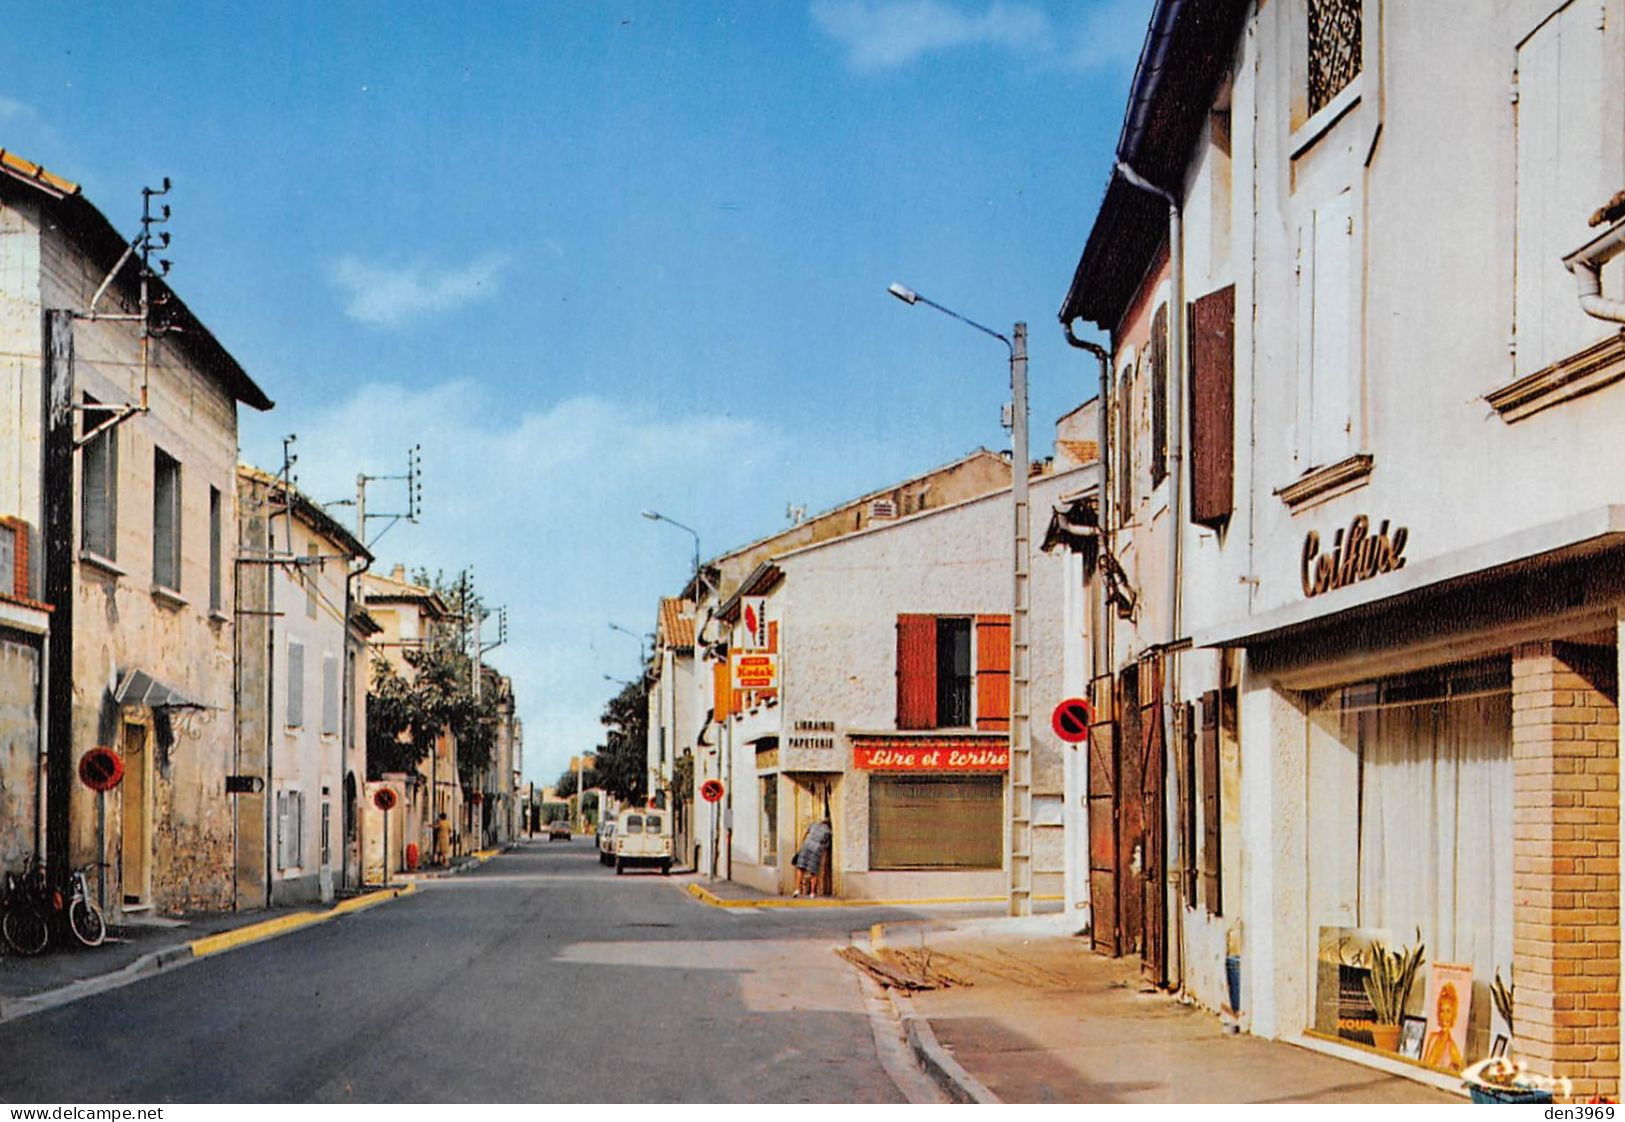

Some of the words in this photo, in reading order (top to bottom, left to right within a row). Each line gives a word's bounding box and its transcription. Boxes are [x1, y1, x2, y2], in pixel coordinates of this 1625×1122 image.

[1301, 514, 1408, 598] Coiffure
[737, 666, 774, 678] Kodak
[794, 720, 834, 732] LIBRAIRIE
[788, 738, 833, 749] PAPETERIE
[867, 750, 915, 767] Lire
[921, 752, 940, 766] et
